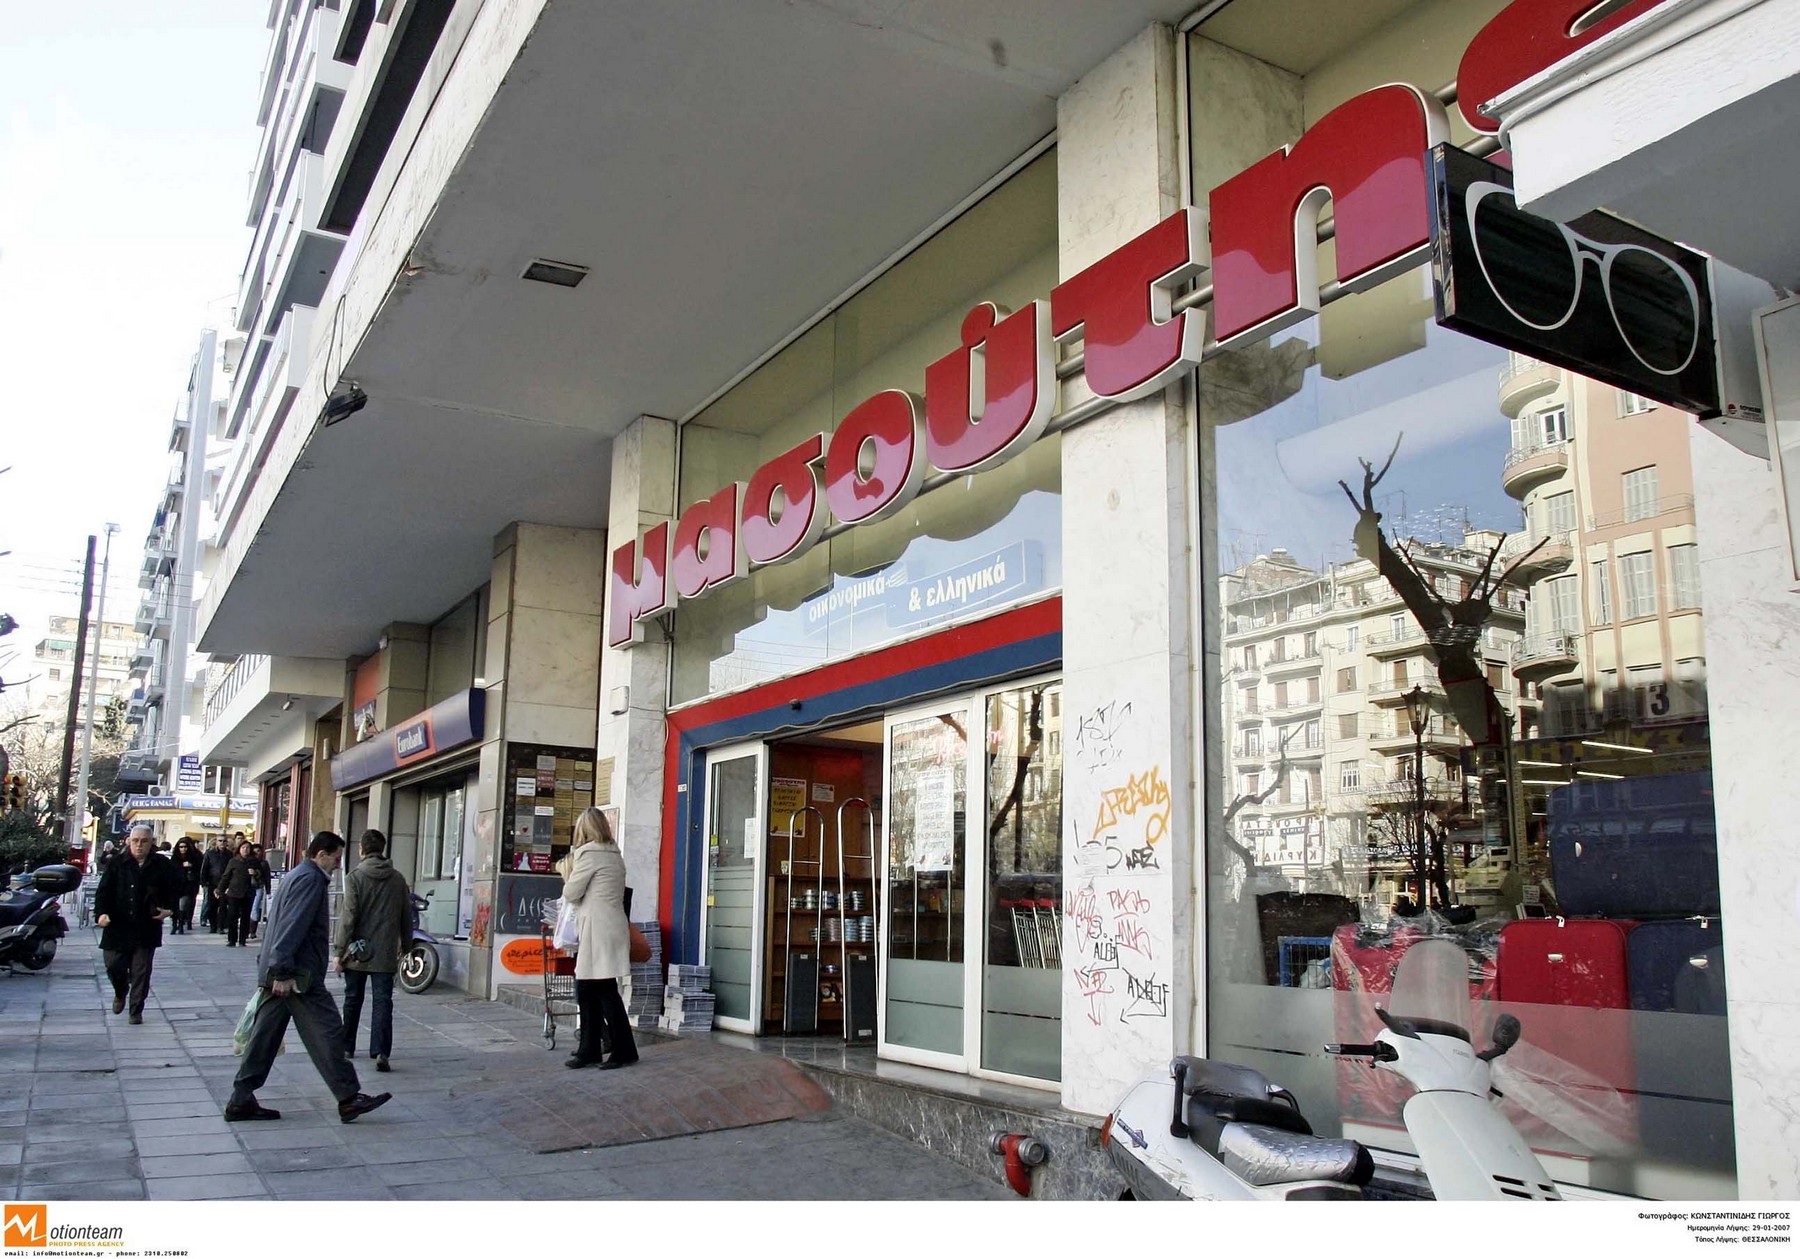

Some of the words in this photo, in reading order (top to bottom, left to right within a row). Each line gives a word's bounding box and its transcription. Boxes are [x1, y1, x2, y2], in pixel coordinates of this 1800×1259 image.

[908, 586, 921, 612] &
[926, 555, 1006, 607] ελληνικά
[397, 726, 423, 754] Eurobank
